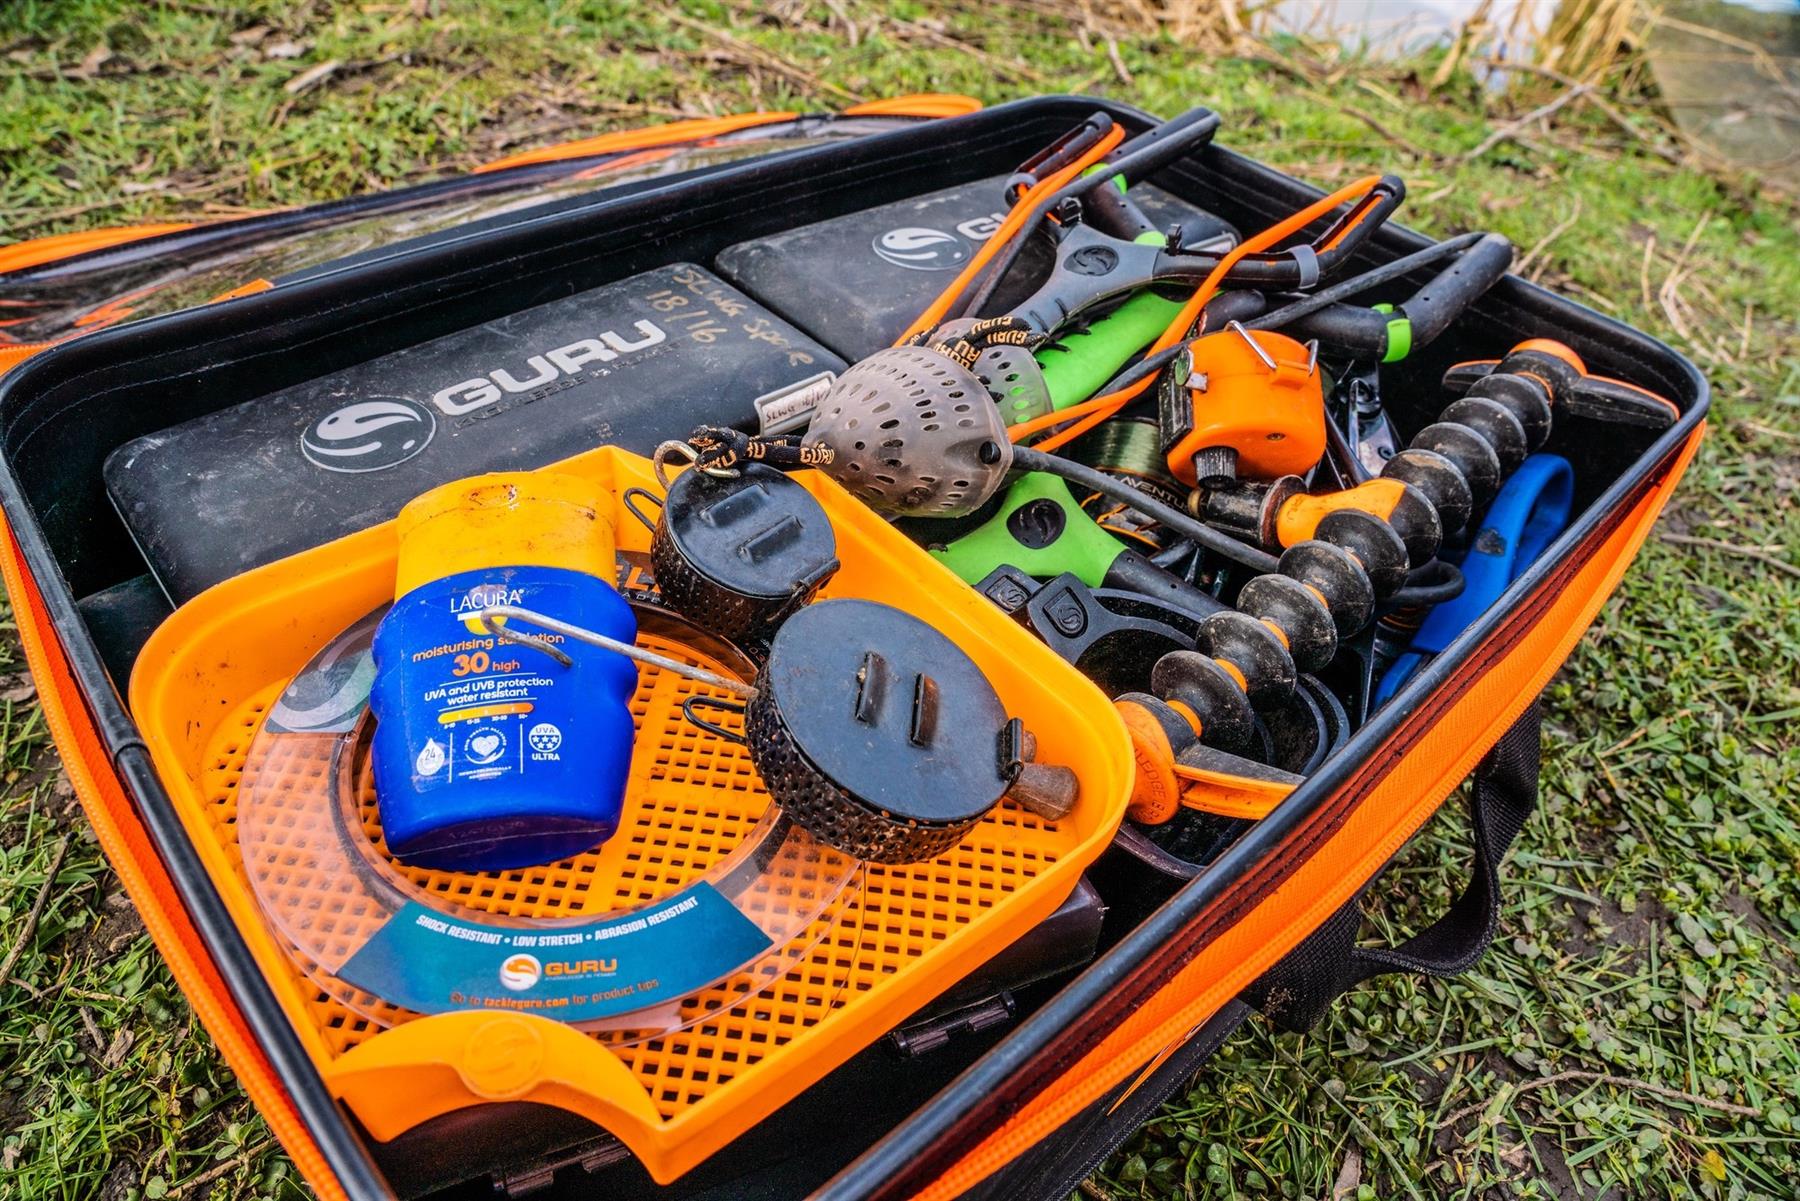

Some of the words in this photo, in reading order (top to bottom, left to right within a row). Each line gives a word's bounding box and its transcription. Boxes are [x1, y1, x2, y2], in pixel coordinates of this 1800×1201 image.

[433, 318, 667, 417] GURU
[800, 447, 835, 465] GURU
[1120, 475, 1190, 511] AVENTU
[450, 589, 523, 613] LACURA
[412, 637, 494, 662] moisturising
[452, 651, 490, 677] 30
[492, 659, 520, 672] high
[424, 689, 447, 701] UVA
[448, 683, 470, 696] and
[472, 679, 495, 691] UVB
[497, 677, 553, 693] protection
[447, 694, 480, 705] water
[480, 687, 528, 700] resistant
[532, 753, 560, 761] ULTRA
[416, 914, 450, 935] SHOCK
[447, 925, 503, 945] RESISTANT
[512, 935, 537, 947] LOW
[538, 933, 583, 947] STRETCH
[595, 918, 648, 941] ABRASION
[646, 896, 699, 926] RESISTANT
[545, 959, 618, 976] GURU
[484, 997, 569, 1010] tackleguru.com
[572, 993, 588, 1004] for
[592, 985, 635, 1003] product
[637, 979, 659, 993] tips
